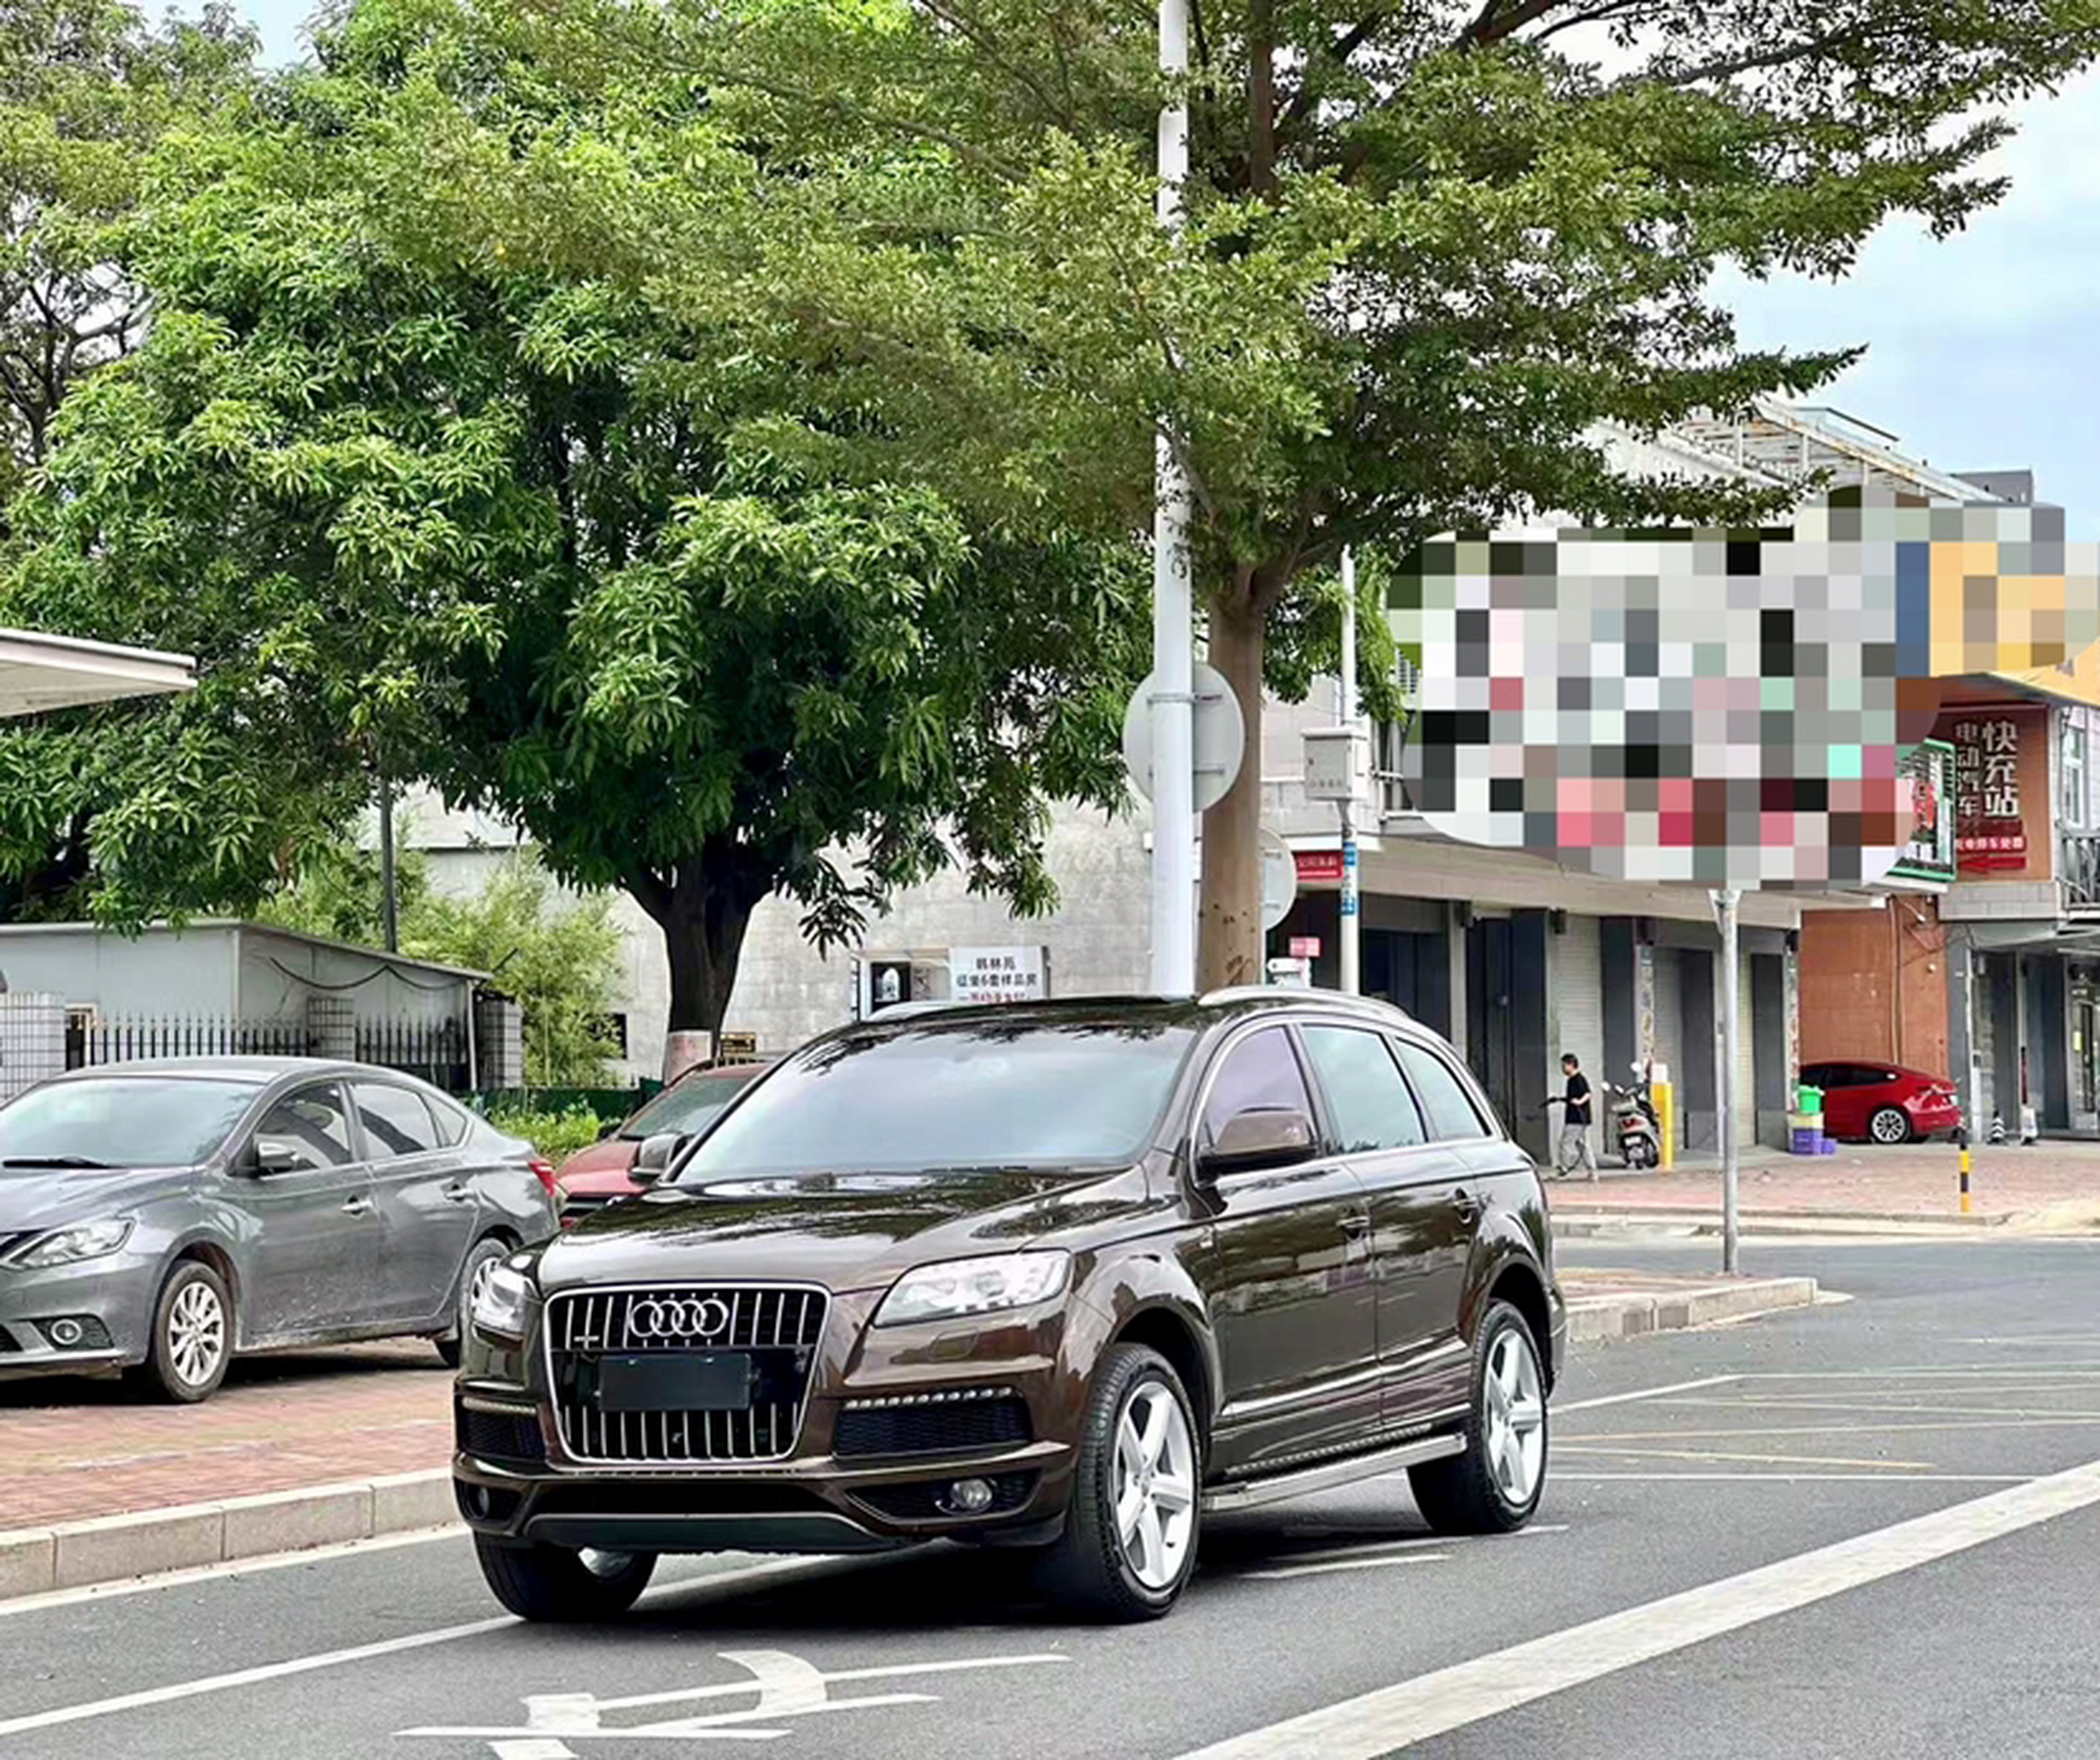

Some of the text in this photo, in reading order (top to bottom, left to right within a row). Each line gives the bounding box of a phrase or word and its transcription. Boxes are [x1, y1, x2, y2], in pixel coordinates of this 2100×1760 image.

[1955, 722, 1980, 817] 电动汽车
[1982, 721, 2019, 817] 快充站
